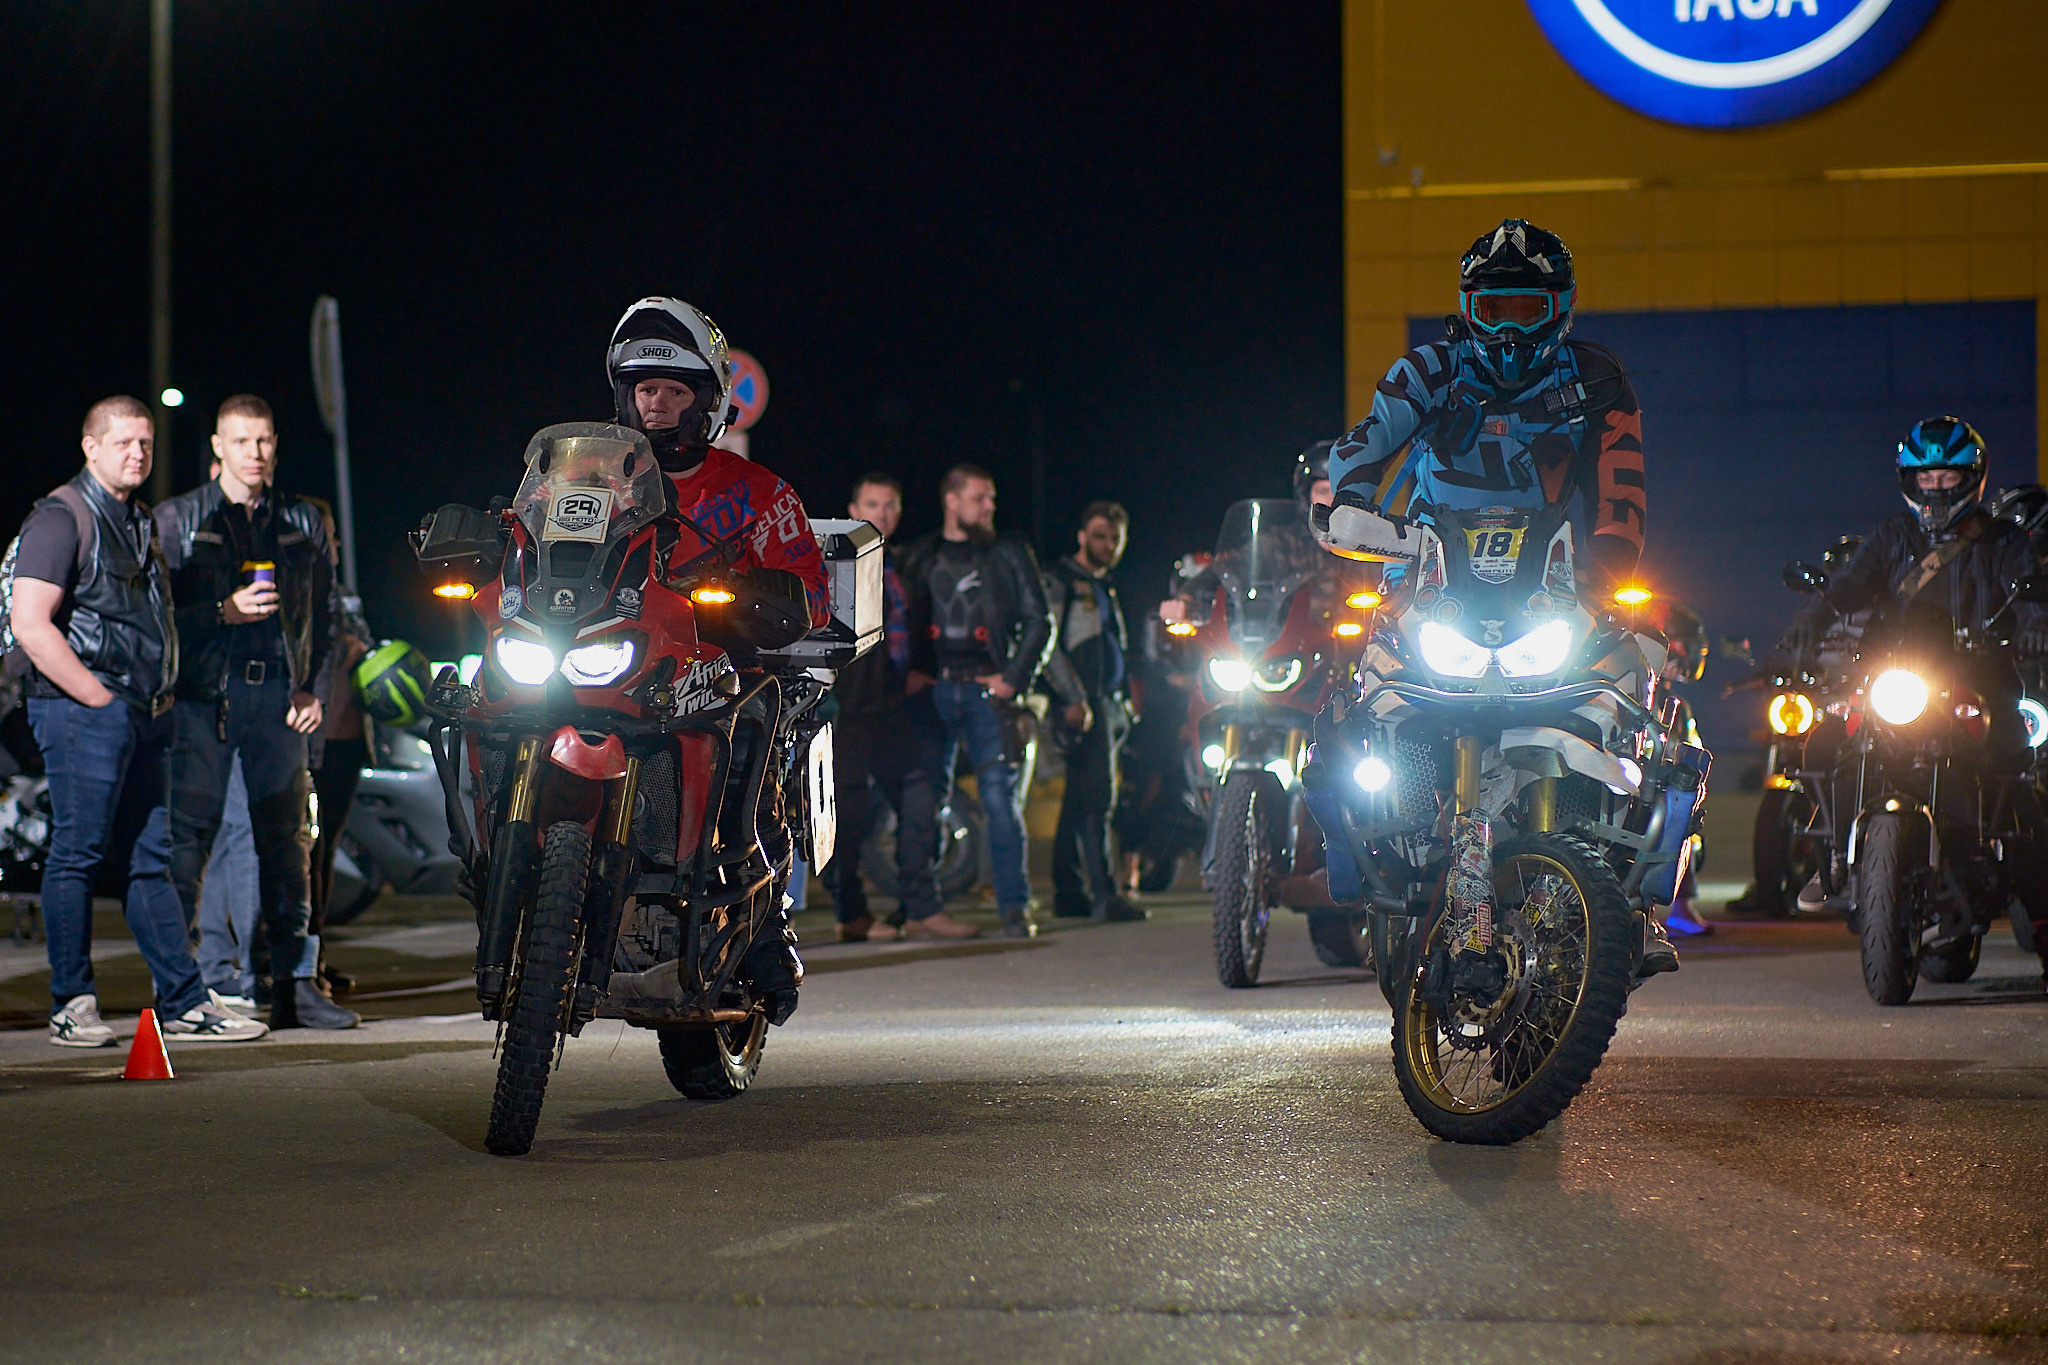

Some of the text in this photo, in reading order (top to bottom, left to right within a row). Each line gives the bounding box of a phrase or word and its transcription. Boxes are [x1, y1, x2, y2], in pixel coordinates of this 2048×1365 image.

[642, 347, 672, 358] SHOEI
[564, 499, 594, 515] 29
[694, 486, 757, 547] FOX
[784, 539, 813, 562] 360
[1473, 531, 1514, 558] 18
[676, 654, 730, 697] Africa
[674, 687, 718, 718] Twin
[1479, 906, 1491, 943] FRAGILE
